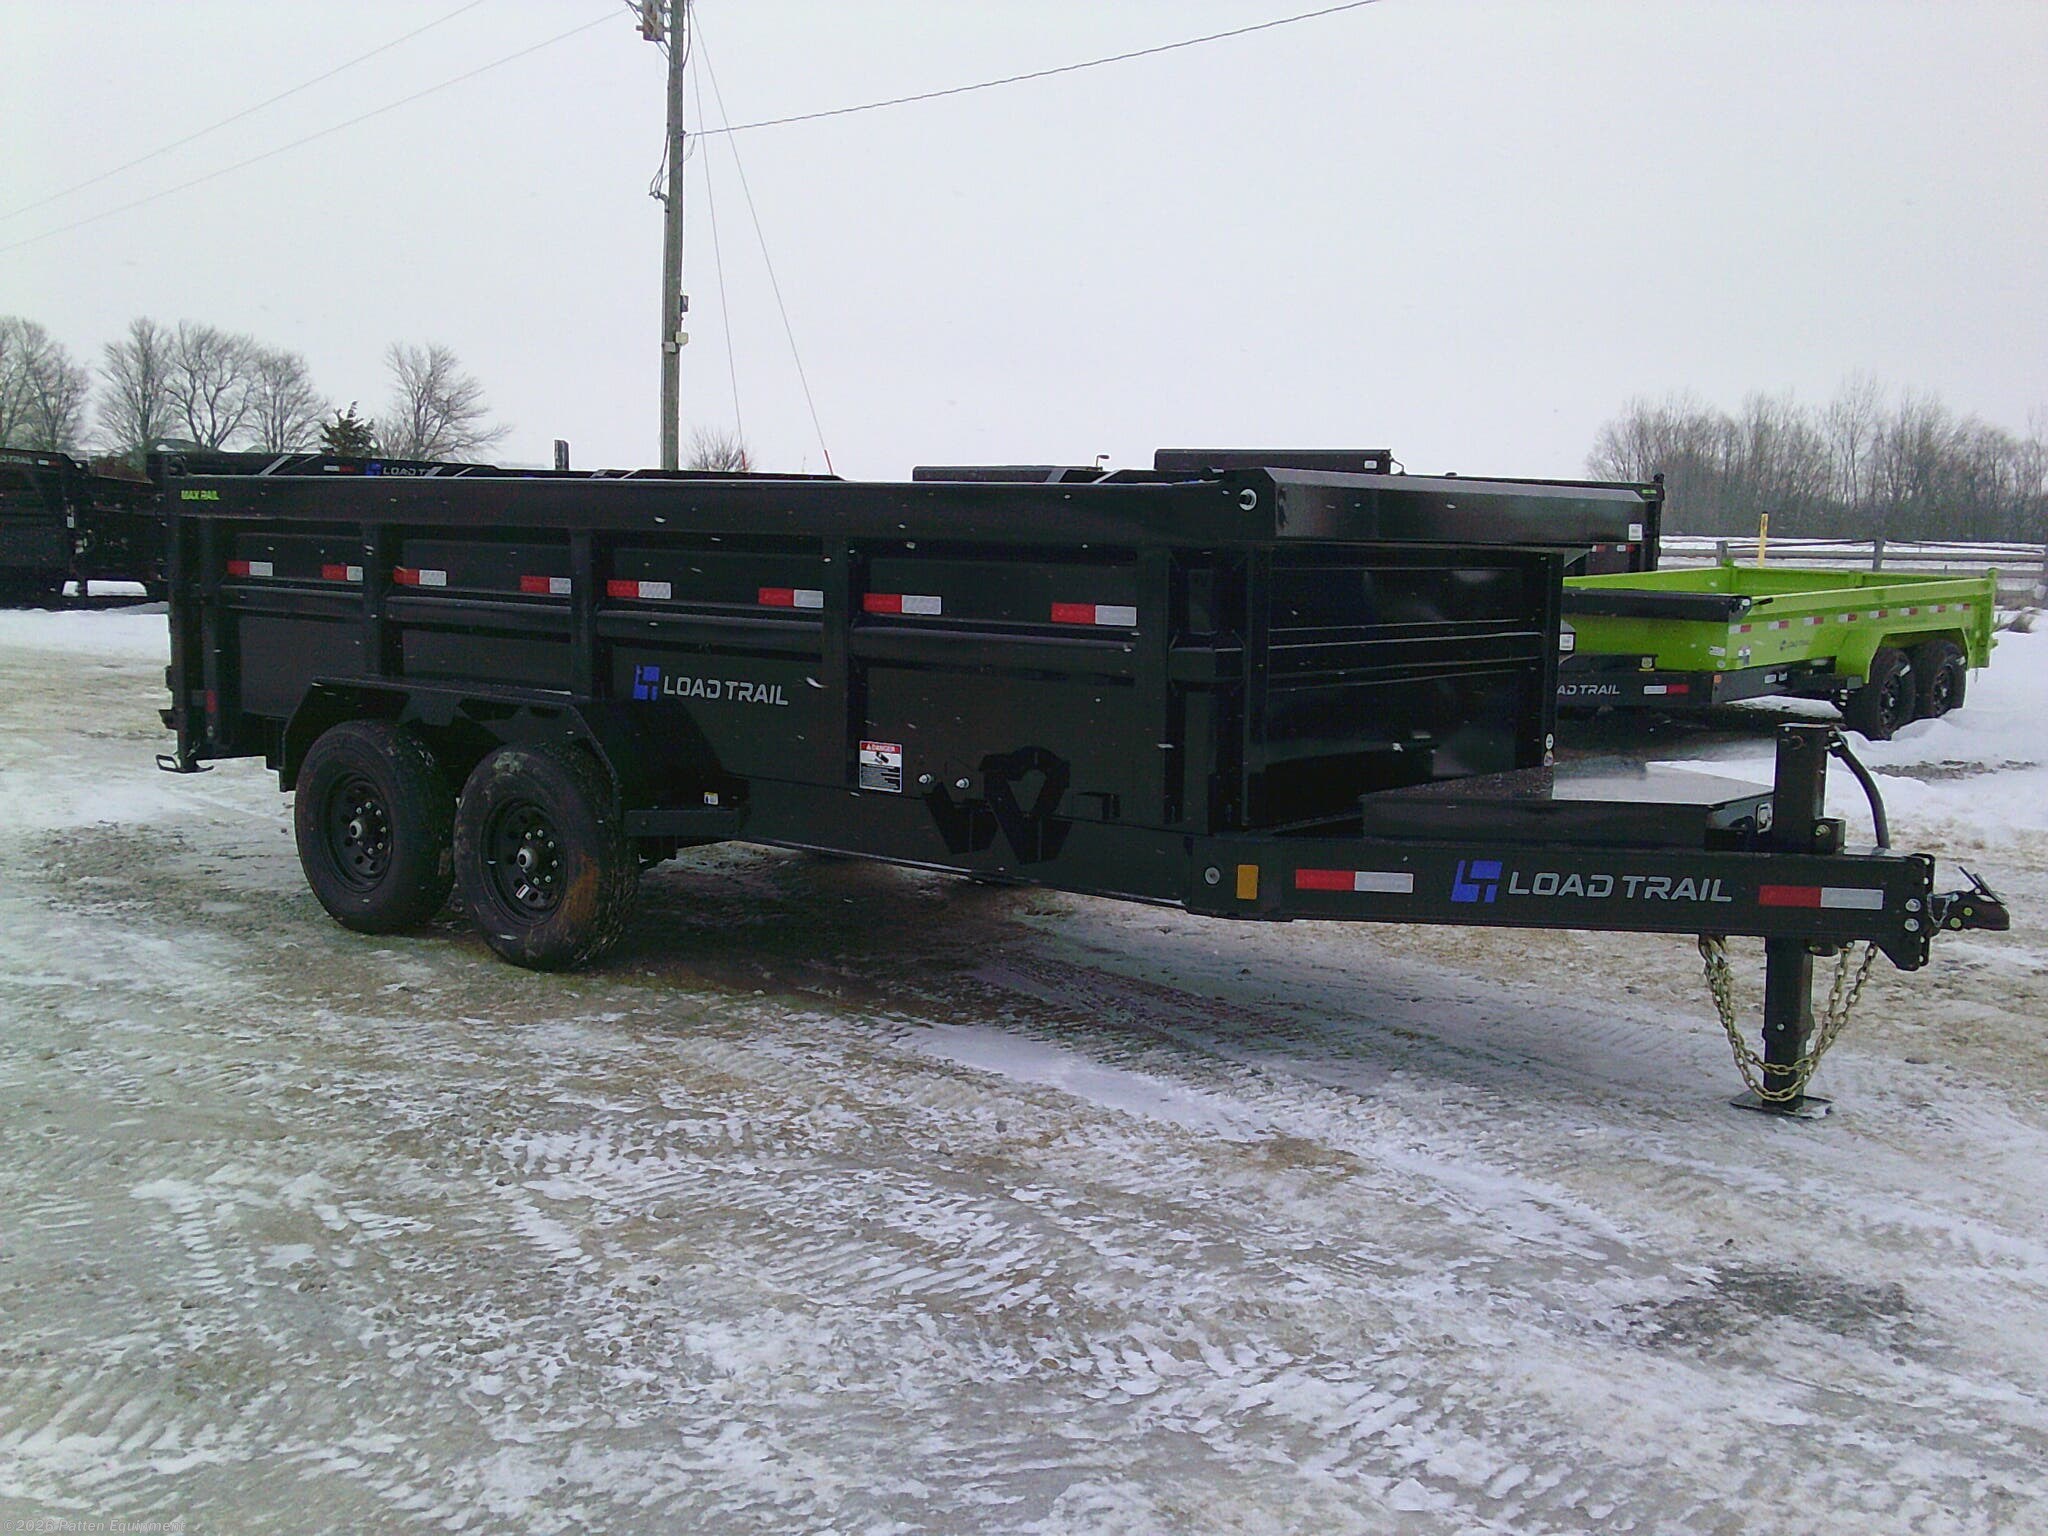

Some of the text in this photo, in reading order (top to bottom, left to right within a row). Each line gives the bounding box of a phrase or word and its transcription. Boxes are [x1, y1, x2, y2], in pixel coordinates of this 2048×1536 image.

[383, 466, 417, 476] LOAD
[663, 675, 789, 706] LOAD TRAIL
[1579, 684, 1620, 695] TRAIL
[1508, 871, 1732, 902] LOAD TRAIL
